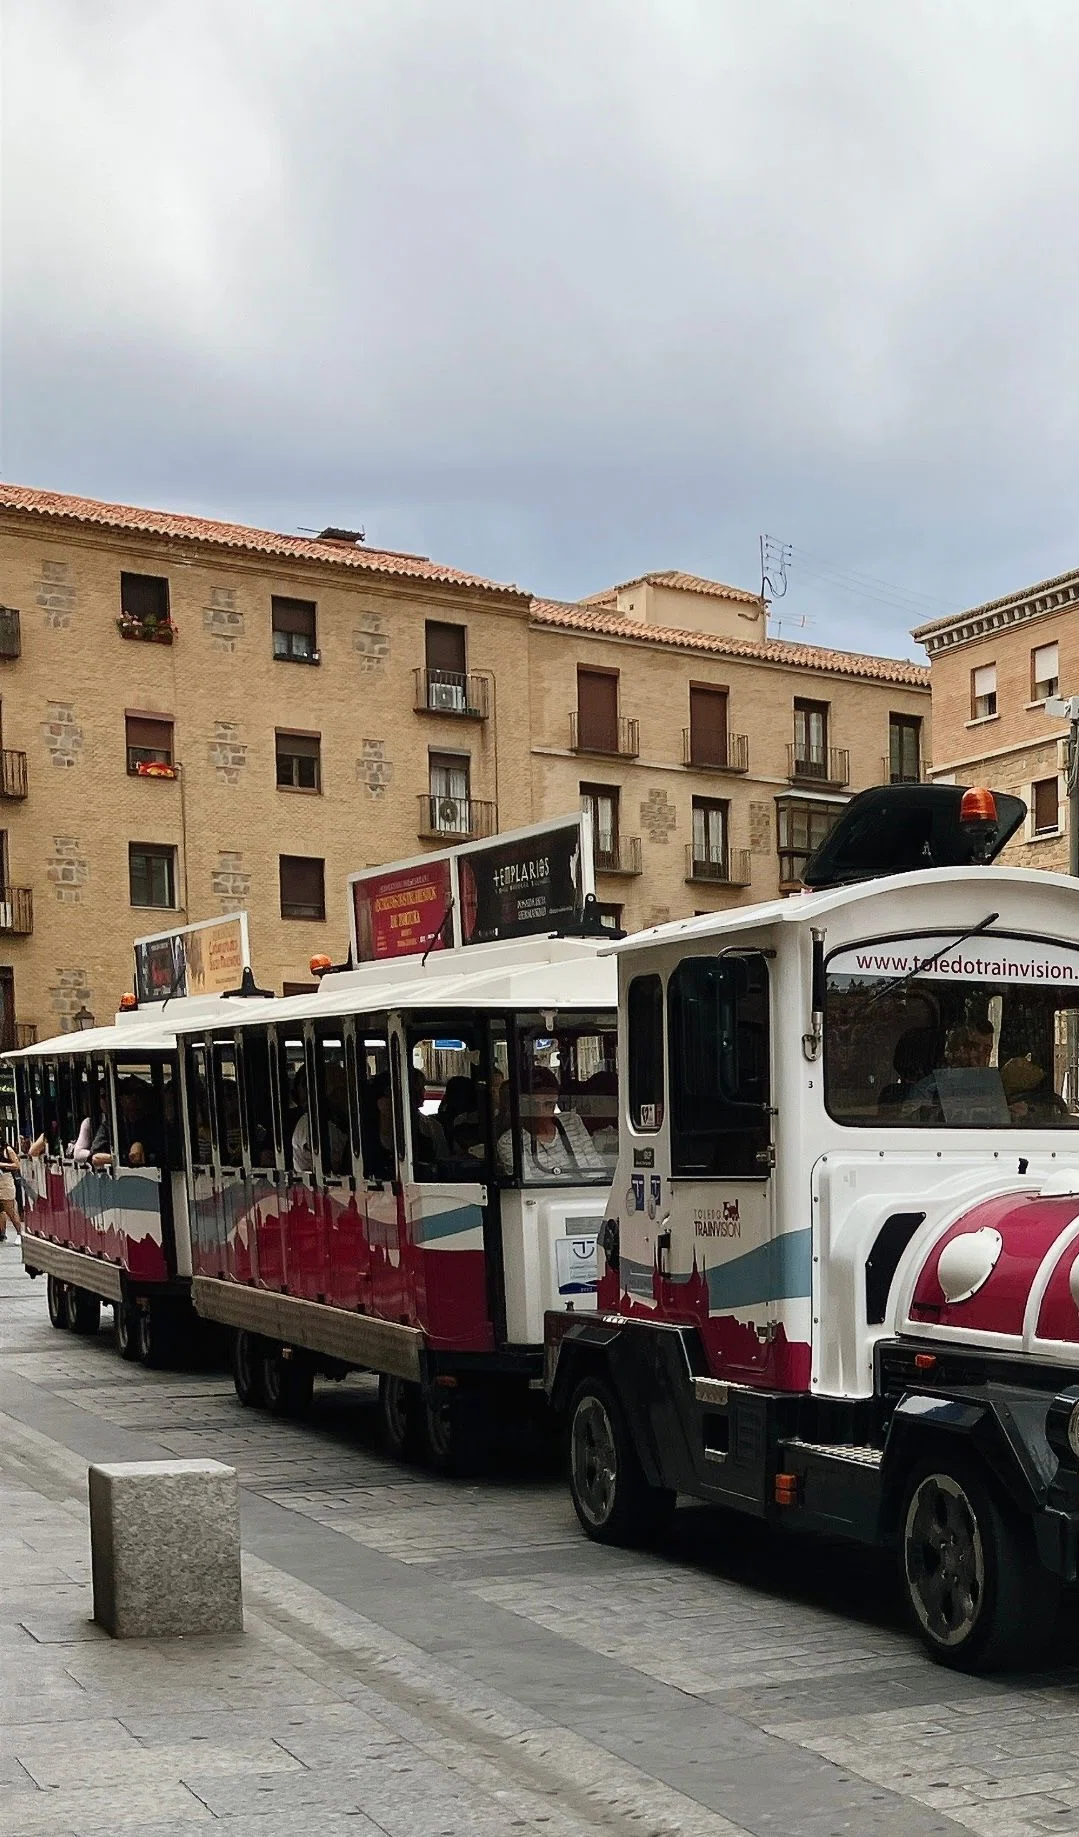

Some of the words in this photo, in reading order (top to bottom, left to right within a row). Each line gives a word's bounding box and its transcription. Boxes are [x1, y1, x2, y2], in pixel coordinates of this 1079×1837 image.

[808, 1080, 814, 1089] 3
[693, 1208, 722, 1220] TOLEDO
[693, 1220, 741, 1238] TRAINVISION
